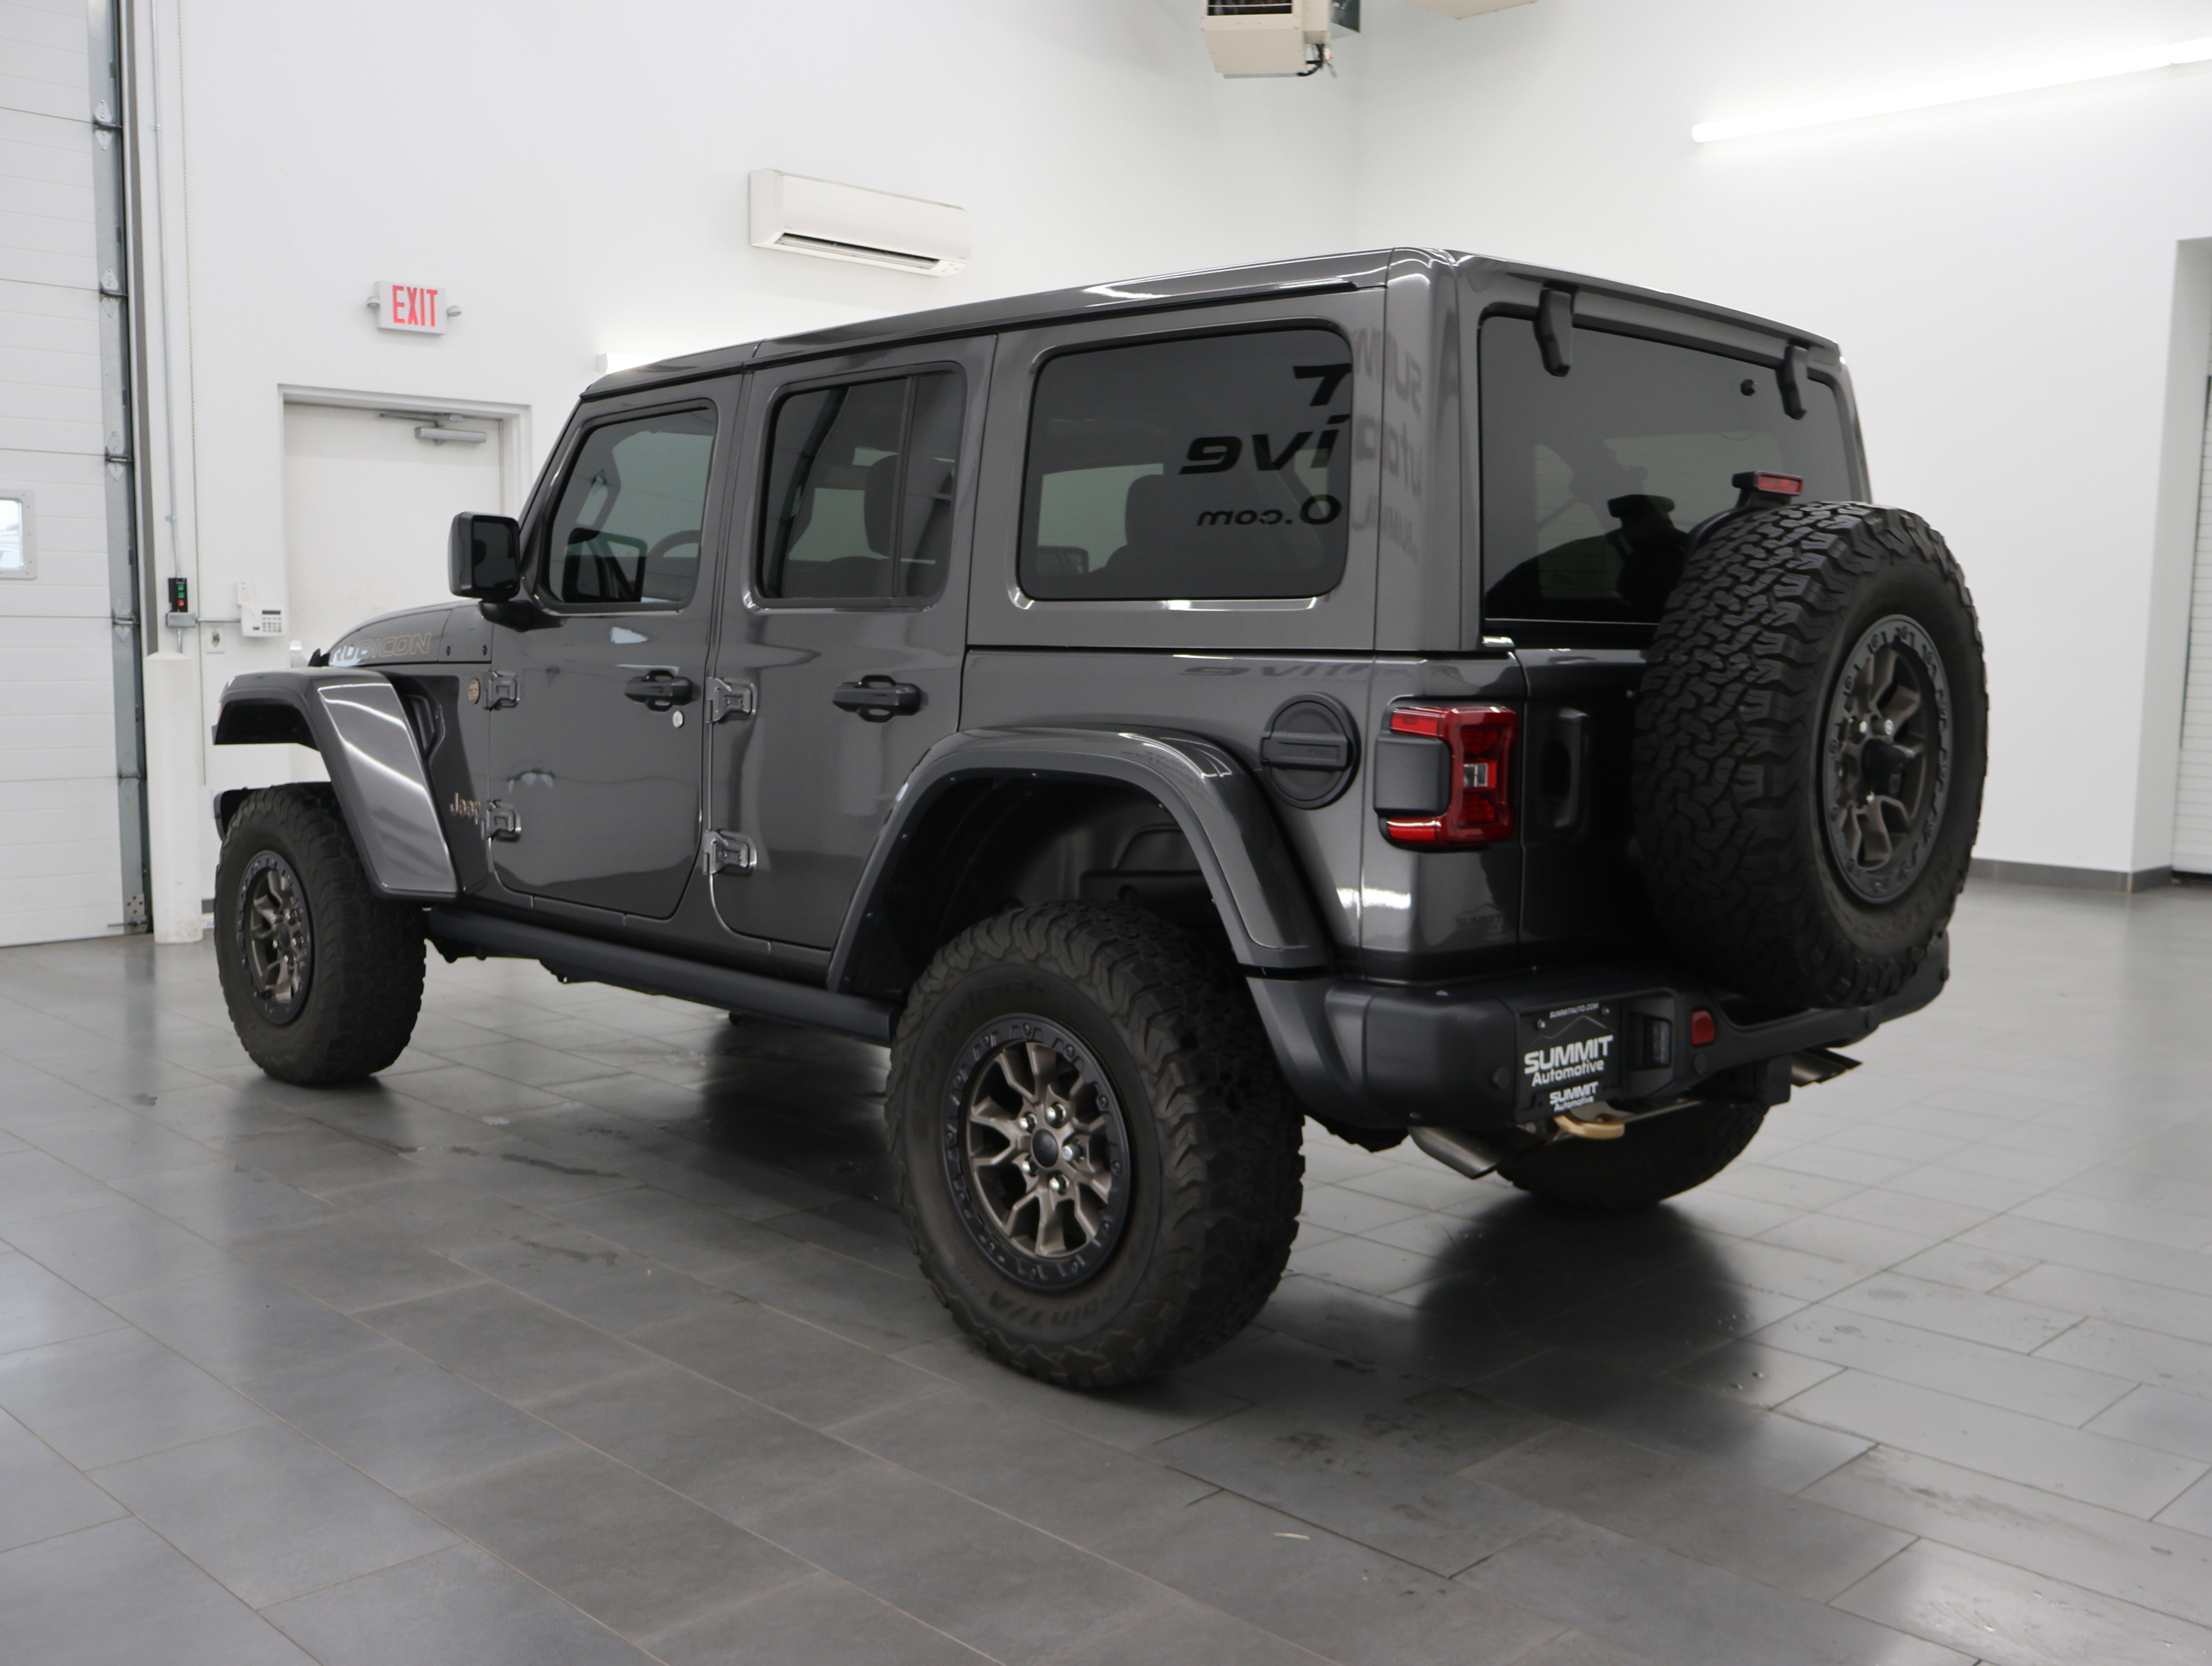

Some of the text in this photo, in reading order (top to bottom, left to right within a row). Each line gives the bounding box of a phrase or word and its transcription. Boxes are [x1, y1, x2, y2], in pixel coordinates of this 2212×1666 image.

[392, 285, 438, 327] EXIT
[332, 632, 432, 662] RUBICON
[1524, 1035, 1613, 1074] SUMMIT
[1532, 1059, 1605, 1087] Automotive
[1549, 1081, 1599, 1105] SUMMIT
[1554, 1096, 1594, 1112] Automotive
